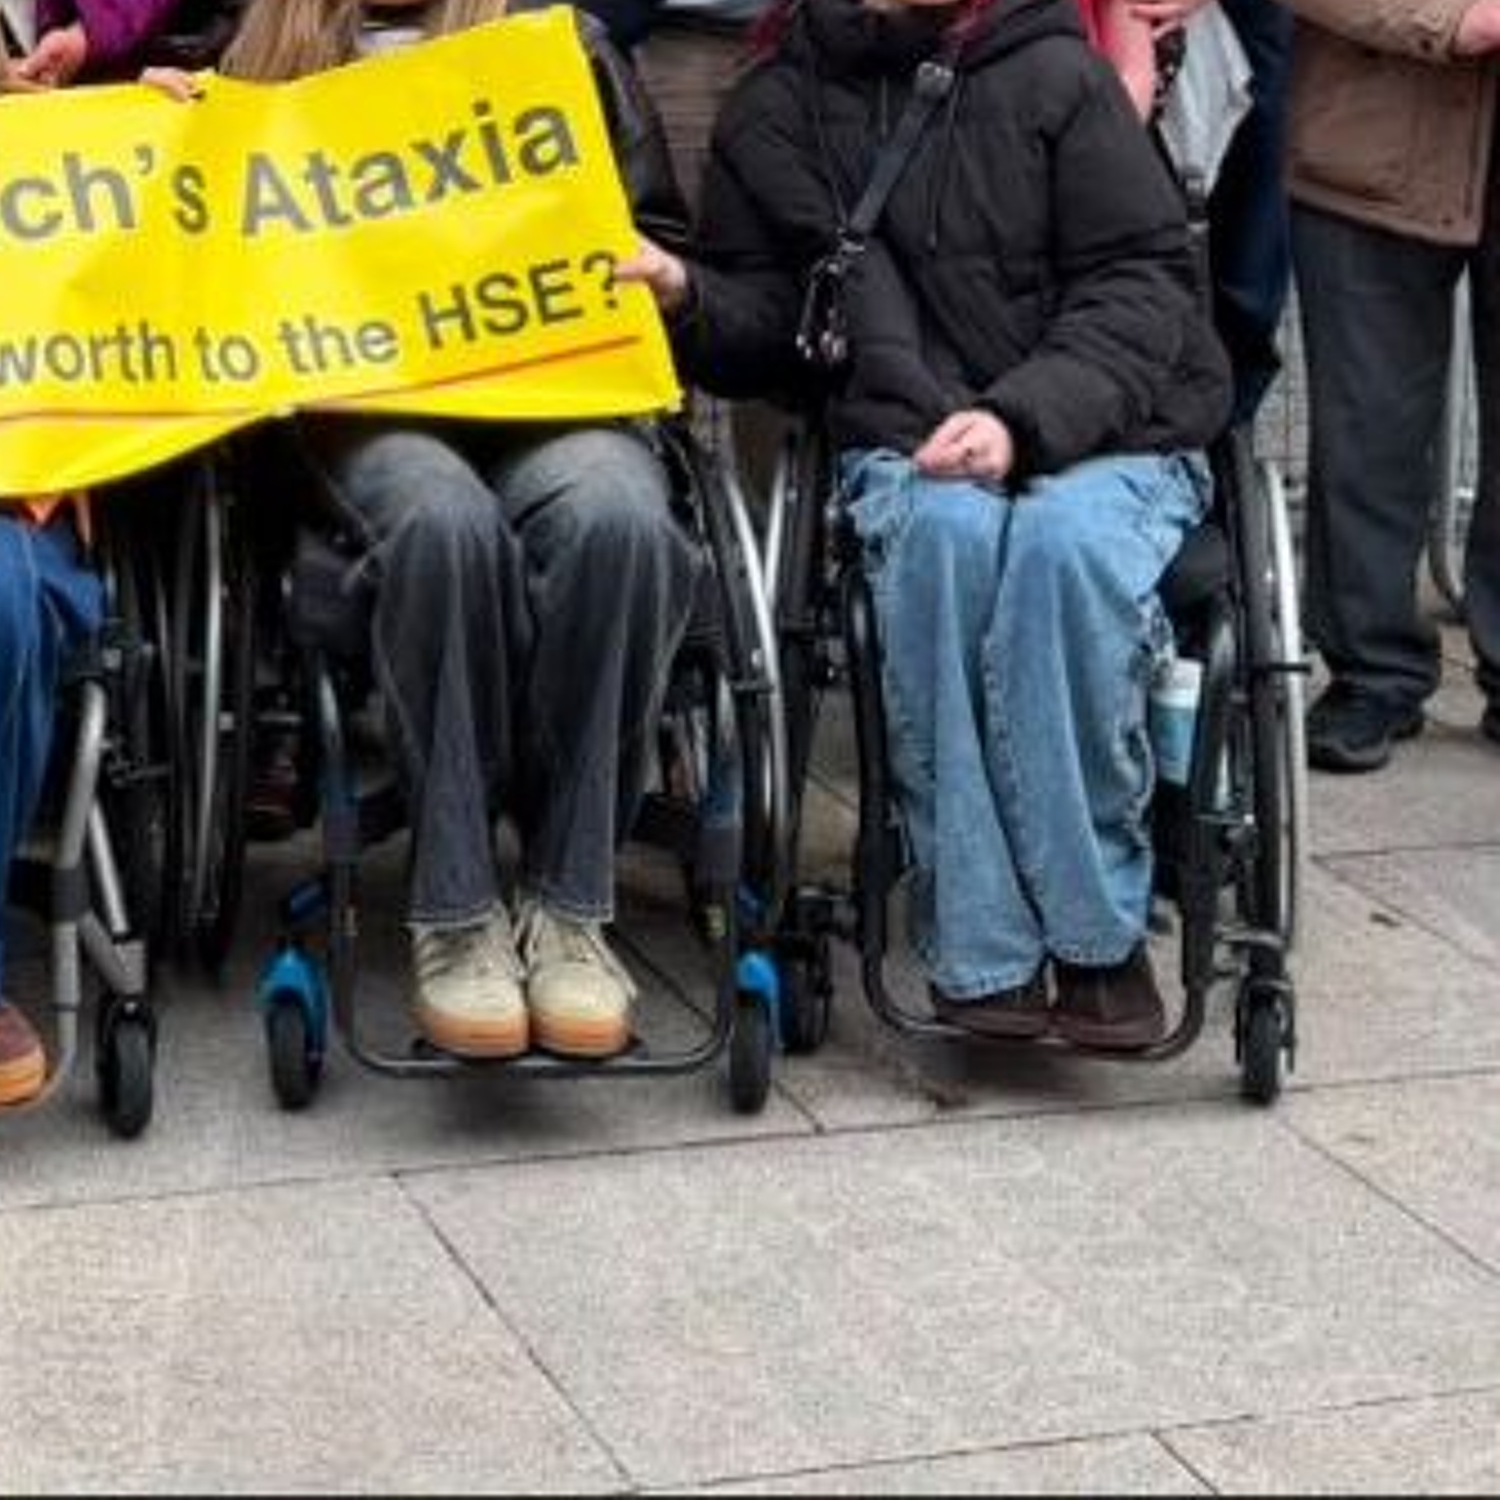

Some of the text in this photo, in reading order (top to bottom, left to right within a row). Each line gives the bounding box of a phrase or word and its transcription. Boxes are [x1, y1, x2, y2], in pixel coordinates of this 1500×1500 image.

[240, 99, 578, 238] Ataxia
[194, 325, 261, 385] to
[280, 311, 400, 376] the
[418, 248, 622, 352] HSE?
